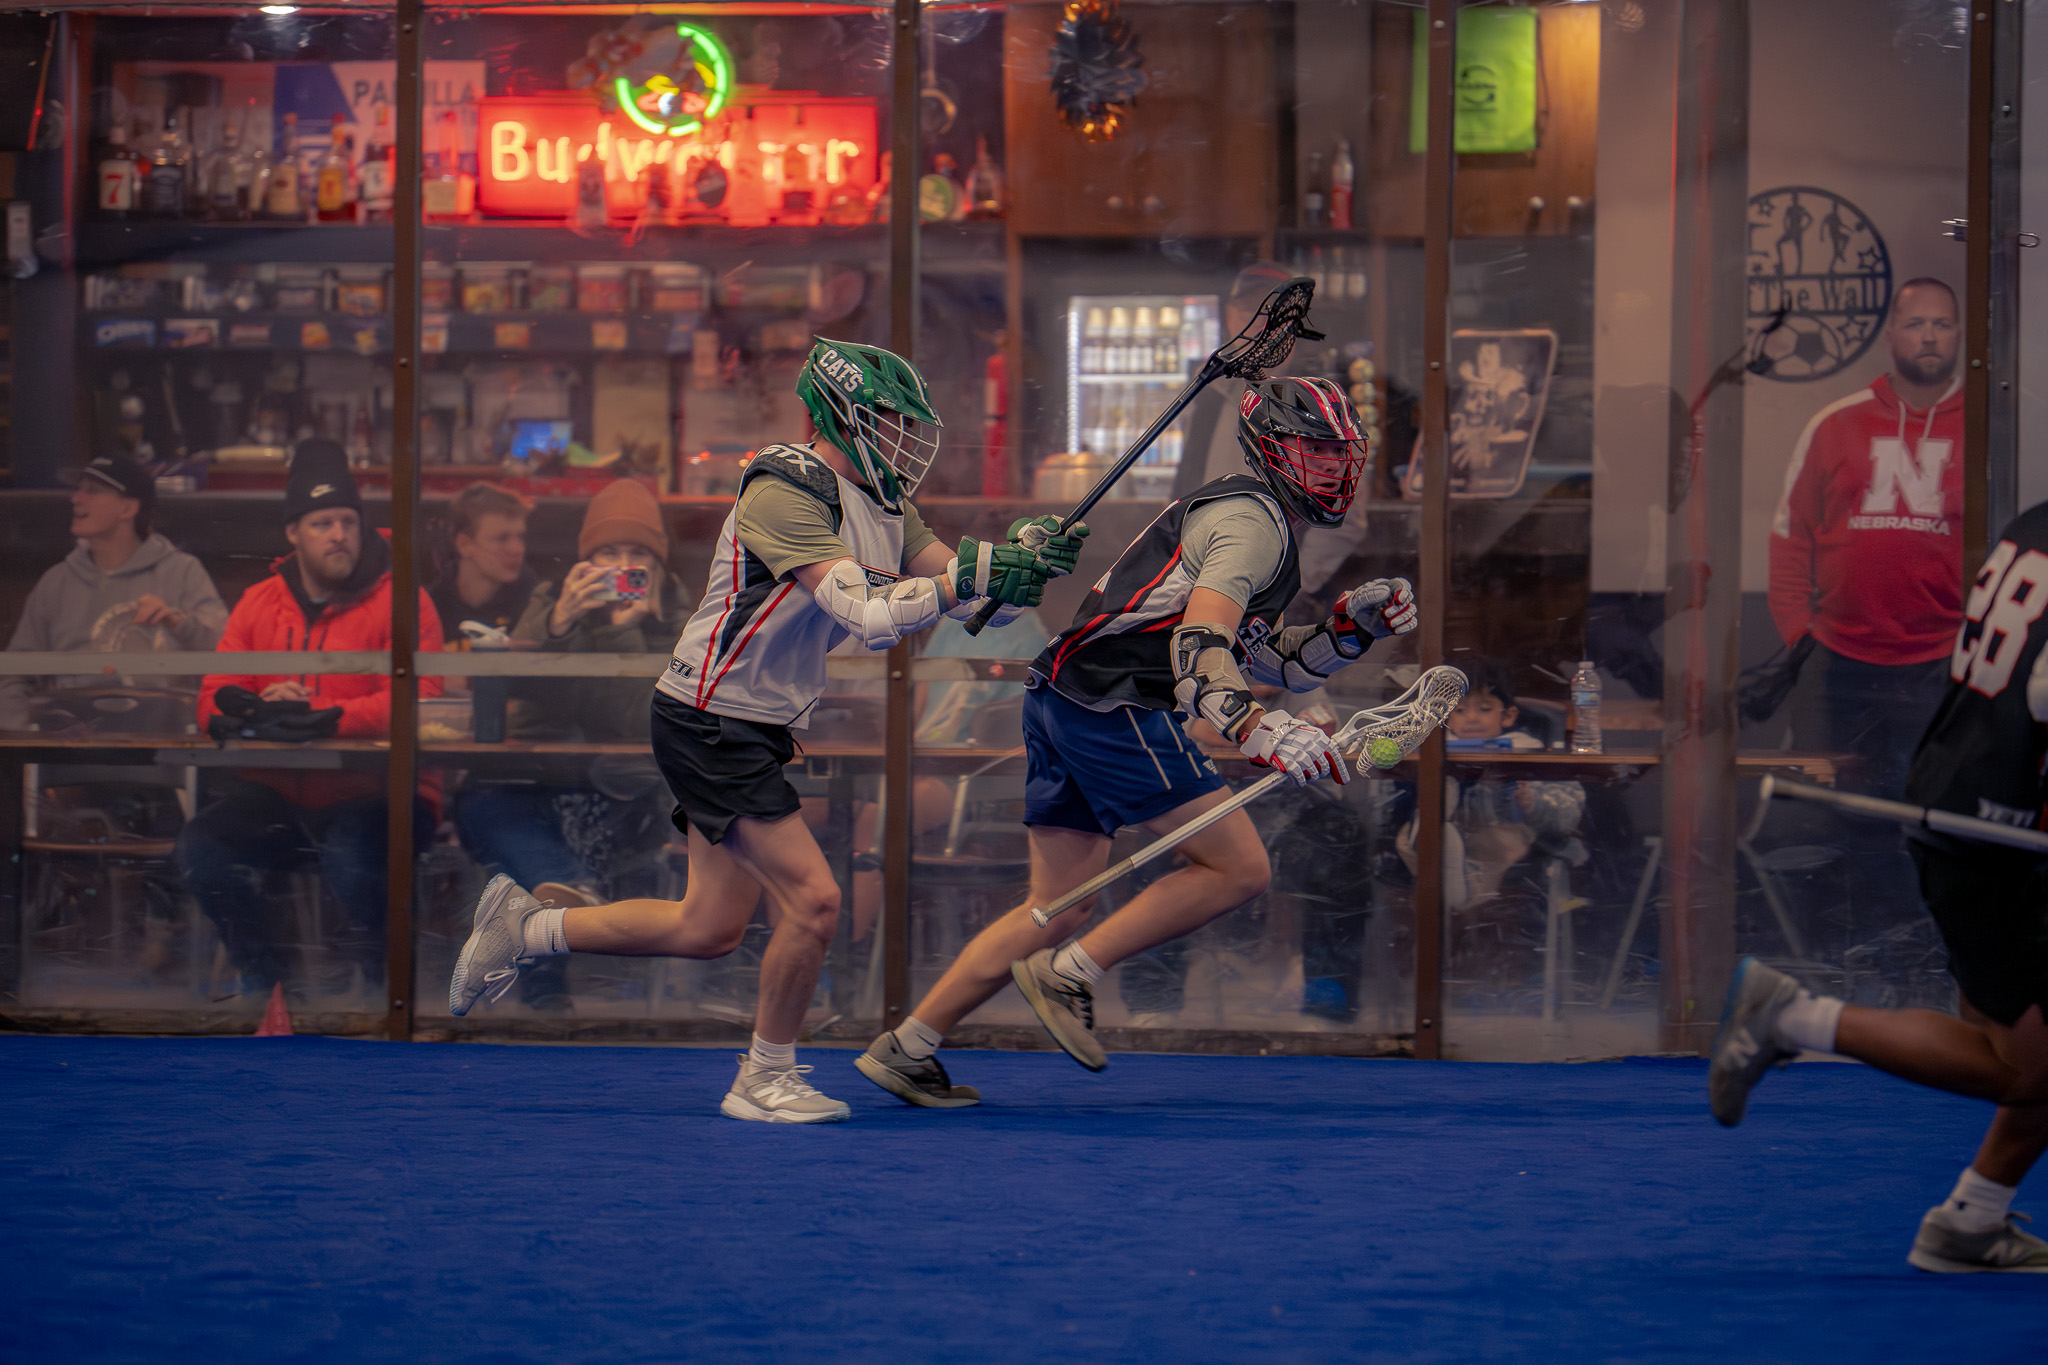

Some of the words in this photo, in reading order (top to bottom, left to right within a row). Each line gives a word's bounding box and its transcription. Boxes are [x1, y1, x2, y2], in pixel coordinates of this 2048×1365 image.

[818, 348, 864, 393] CATS
[1860, 436, 1954, 518] N
[1847, 515, 1951, 536] NEBRASKA
[1951, 539, 2048, 699] 28
